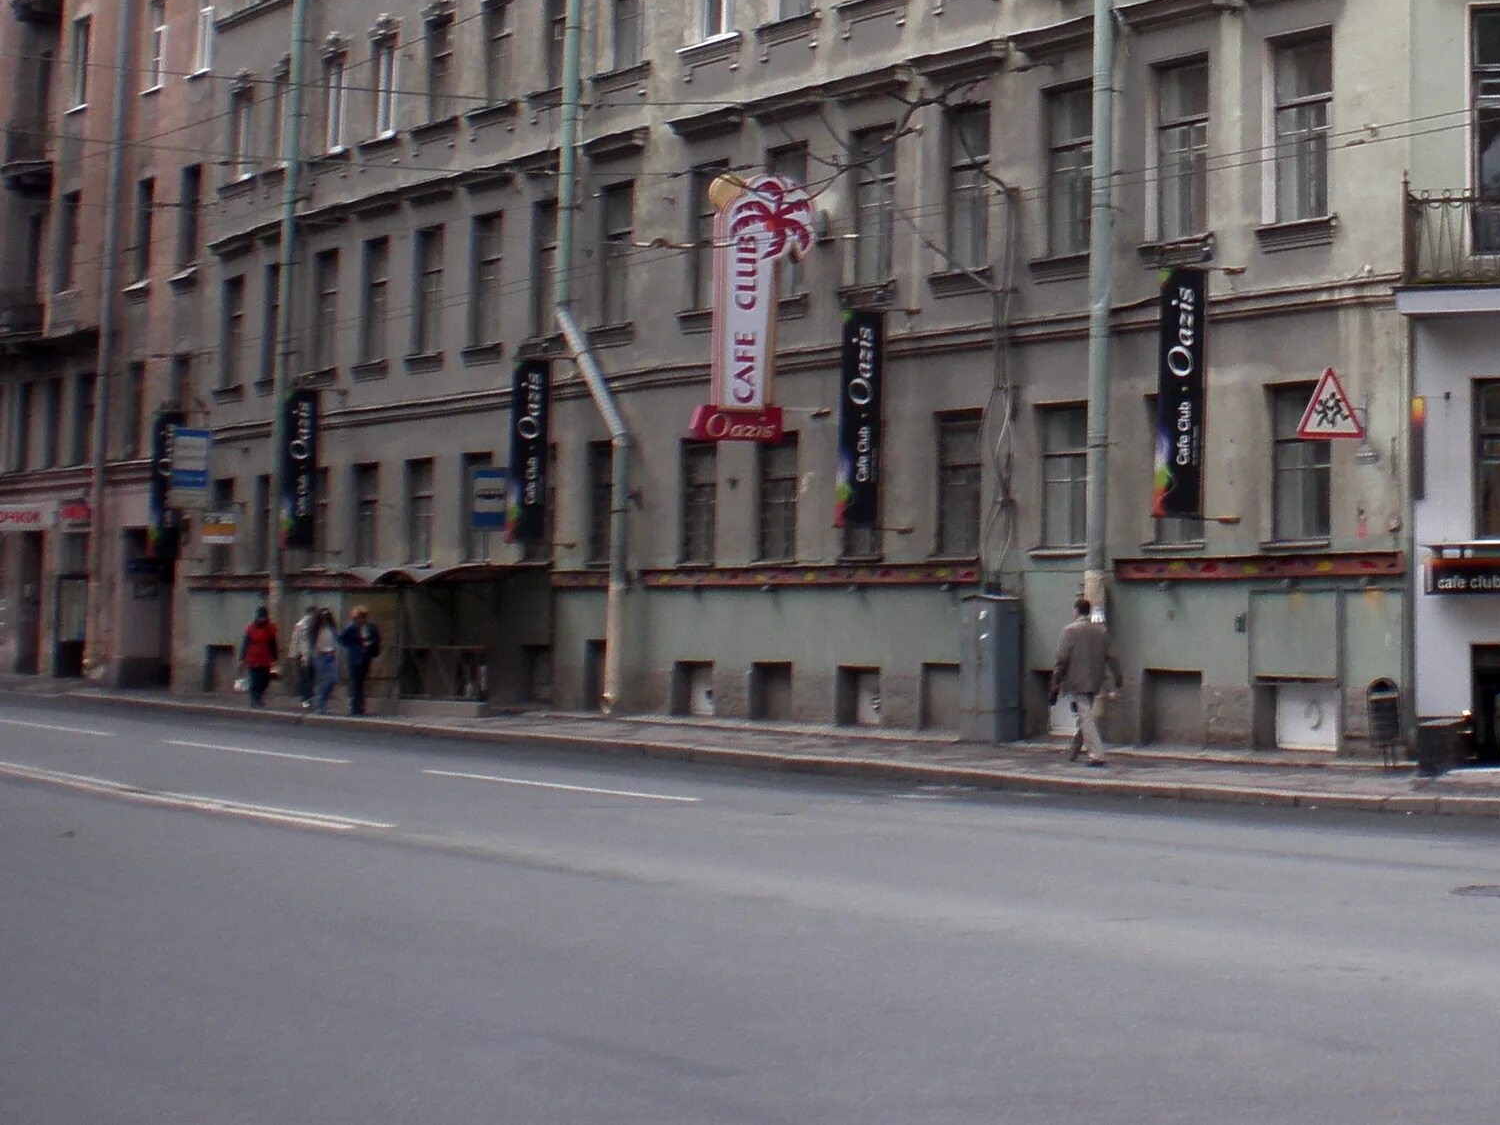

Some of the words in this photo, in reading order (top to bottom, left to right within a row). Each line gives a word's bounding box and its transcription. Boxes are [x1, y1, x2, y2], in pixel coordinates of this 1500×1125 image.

[734, 234, 759, 311] CLUB
[1167, 286, 1195, 377] Oazis
[732, 331, 756, 405] CAFE
[848, 326, 874, 405] Oazis
[517, 372, 542, 440] Oazis
[705, 413, 776, 438] Oazis
[1177, 401, 1192, 432] Club
[288, 402, 311, 460] Oazis
[857, 426, 871, 453] Club
[1176, 434, 1191, 466] Cafe
[855, 455, 869, 483] Cafe
[1437, 575, 1466, 589] cafe
